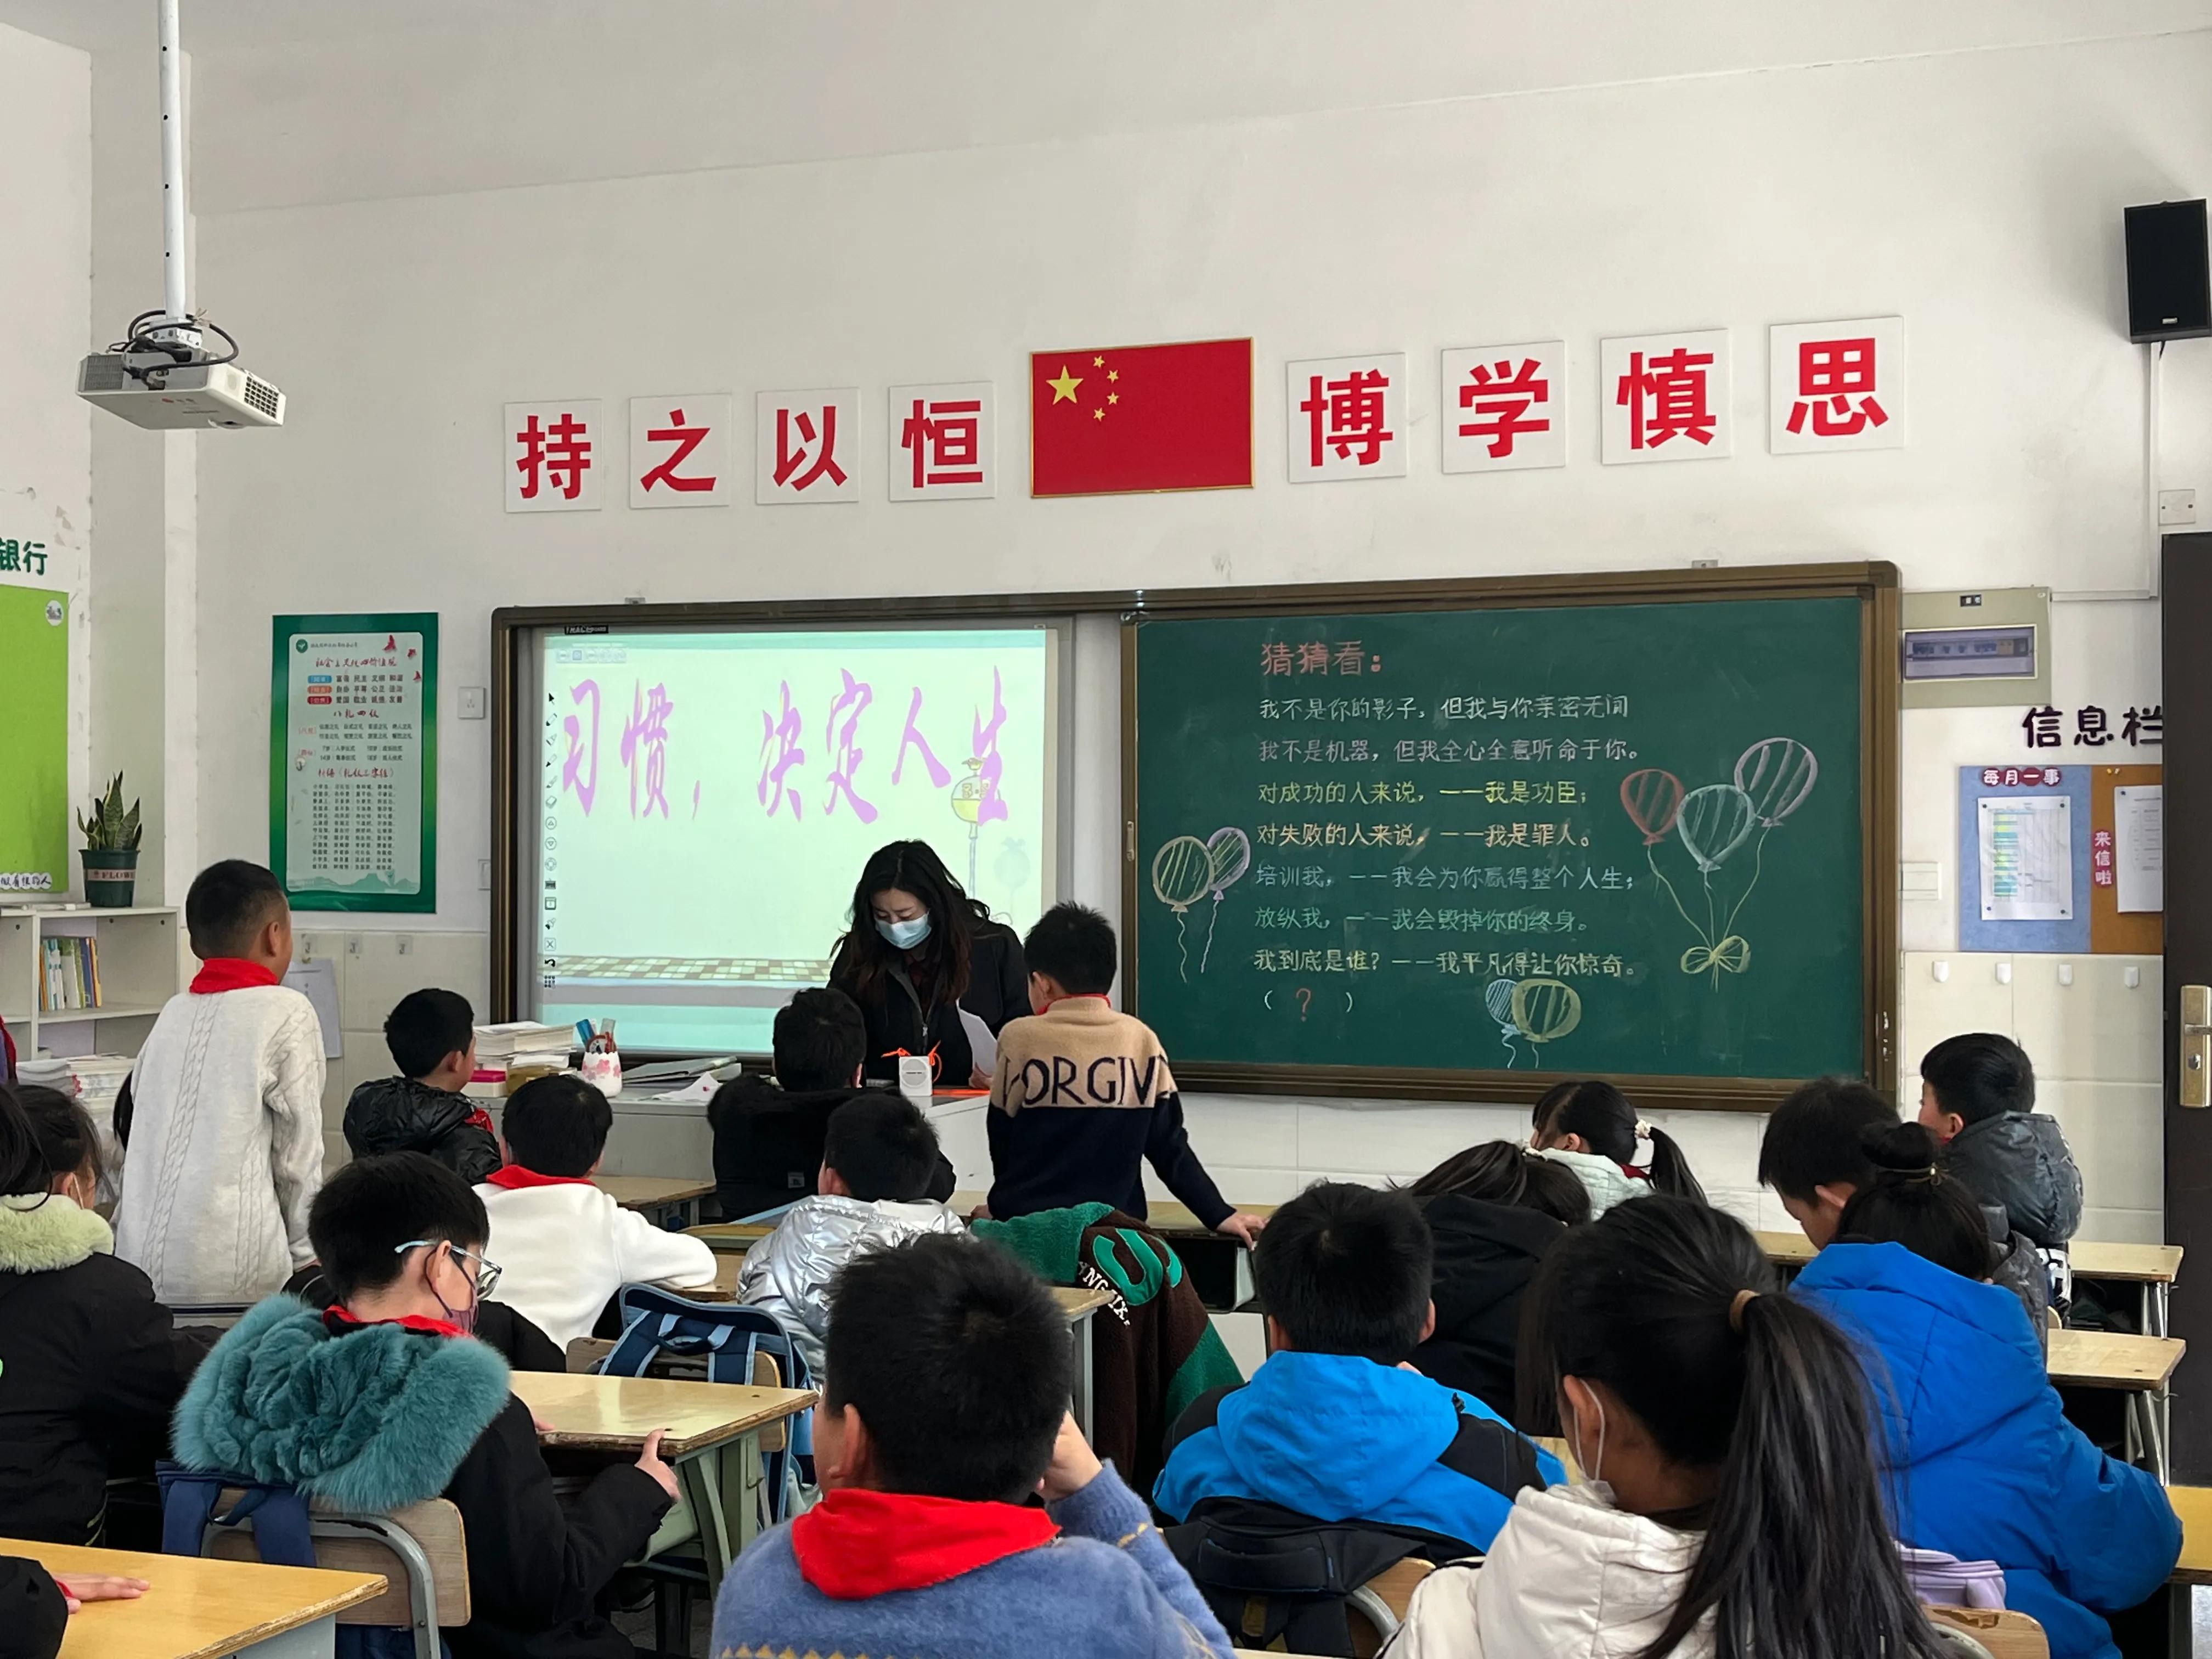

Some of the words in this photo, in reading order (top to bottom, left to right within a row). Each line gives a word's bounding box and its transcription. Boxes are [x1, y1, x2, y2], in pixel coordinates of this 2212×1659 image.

[1300, 338, 1889, 467] 博学慎思
[516, 399, 983, 500] 持之以恒
[1260, 640, 1381, 676] 猜猜看：
[2022, 704, 2163, 747] 信息栏
[1983, 769, 2060, 785] 每月一事
[2094, 831, 2112, 885] 来信啦
[1003, 1055, 1169, 1106] FORGIV
